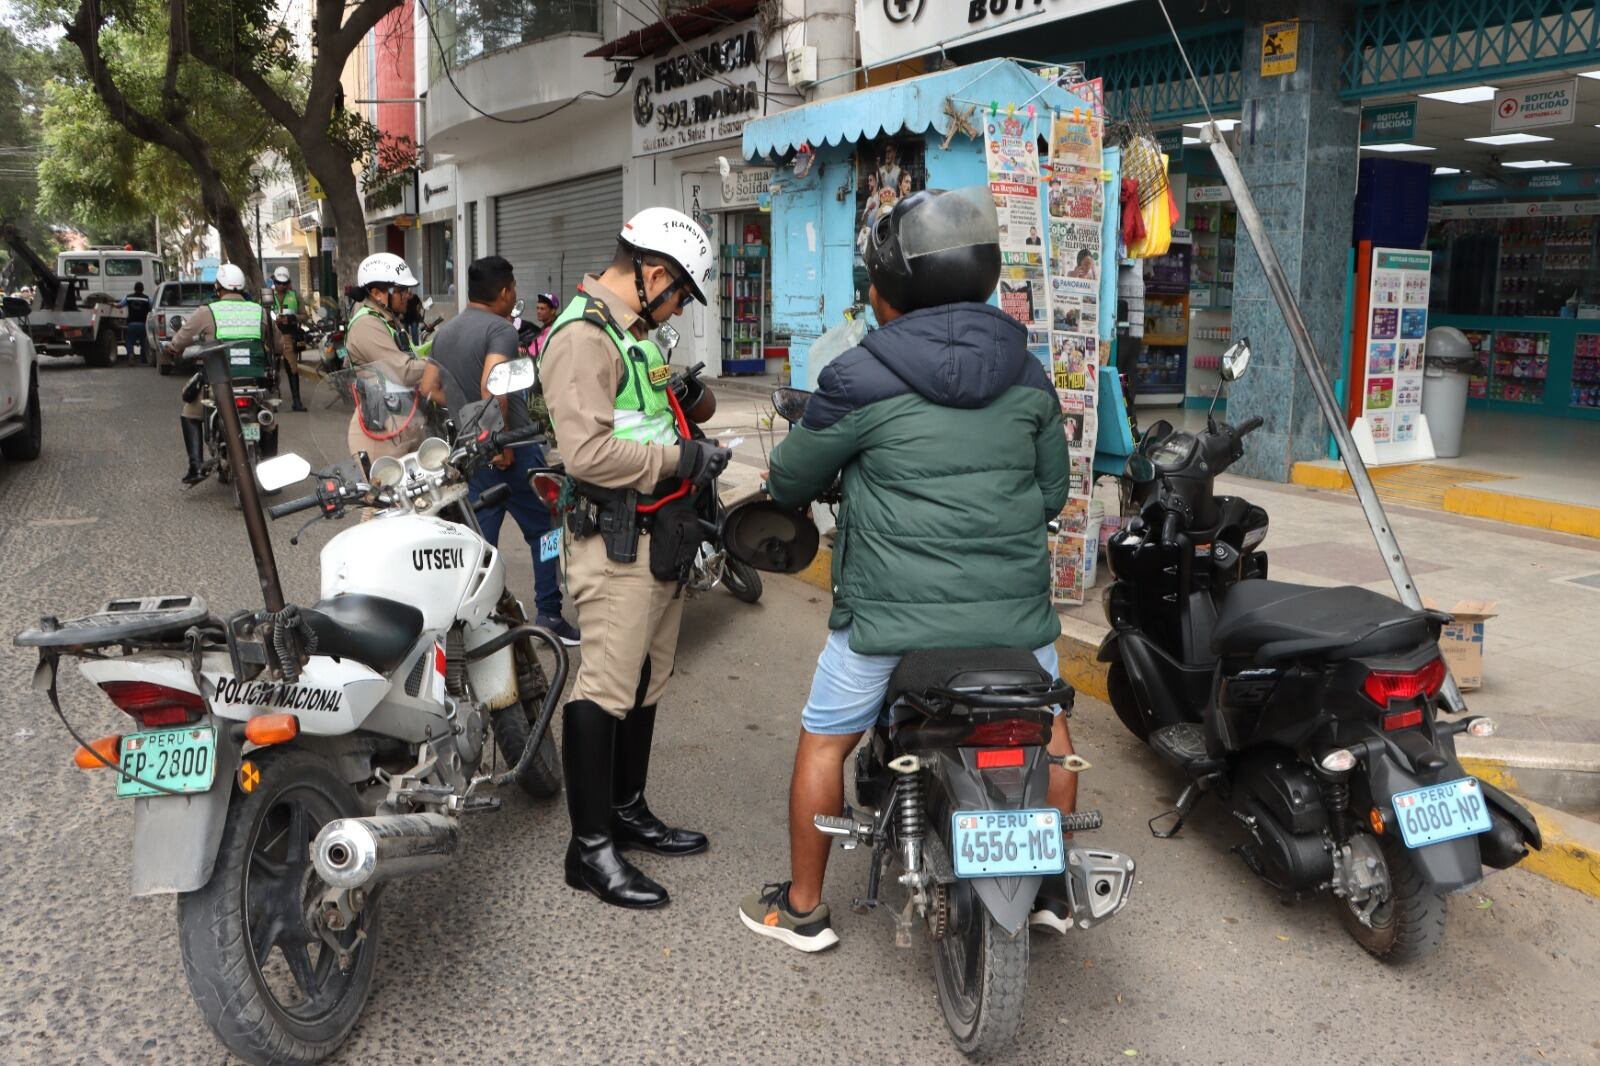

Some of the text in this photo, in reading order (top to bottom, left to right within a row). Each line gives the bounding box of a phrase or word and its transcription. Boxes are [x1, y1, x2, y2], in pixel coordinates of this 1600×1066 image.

[654, 30, 760, 93] FARMACIA
[1525, 90, 1566, 102] BOTICAS
[657, 81, 760, 132] SOLIDARIA
[1520, 98, 1569, 112] FELICIDAD
[1376, 111, 1409, 121] BOTICAS
[1372, 119, 1412, 130] FELICIDAD
[737, 170, 769, 183] Farma
[1529, 180, 1562, 188] FELICIDAD
[736, 181, 769, 196] Solida
[991, 183, 1000, 192] La
[663, 220, 707, 256] TRANSITO
[412, 548, 465, 571] UTSEVI
[273, 687, 343, 713] NACIONAL
[149, 733, 186, 748] PERU
[122, 746, 208, 784] EP-2800
[1420, 786, 1454, 803] PERU
[986, 815, 1028, 828] PERU
[1406, 794, 1481, 835] 6080-NP
[961, 829, 1057, 863] 4556-MC
